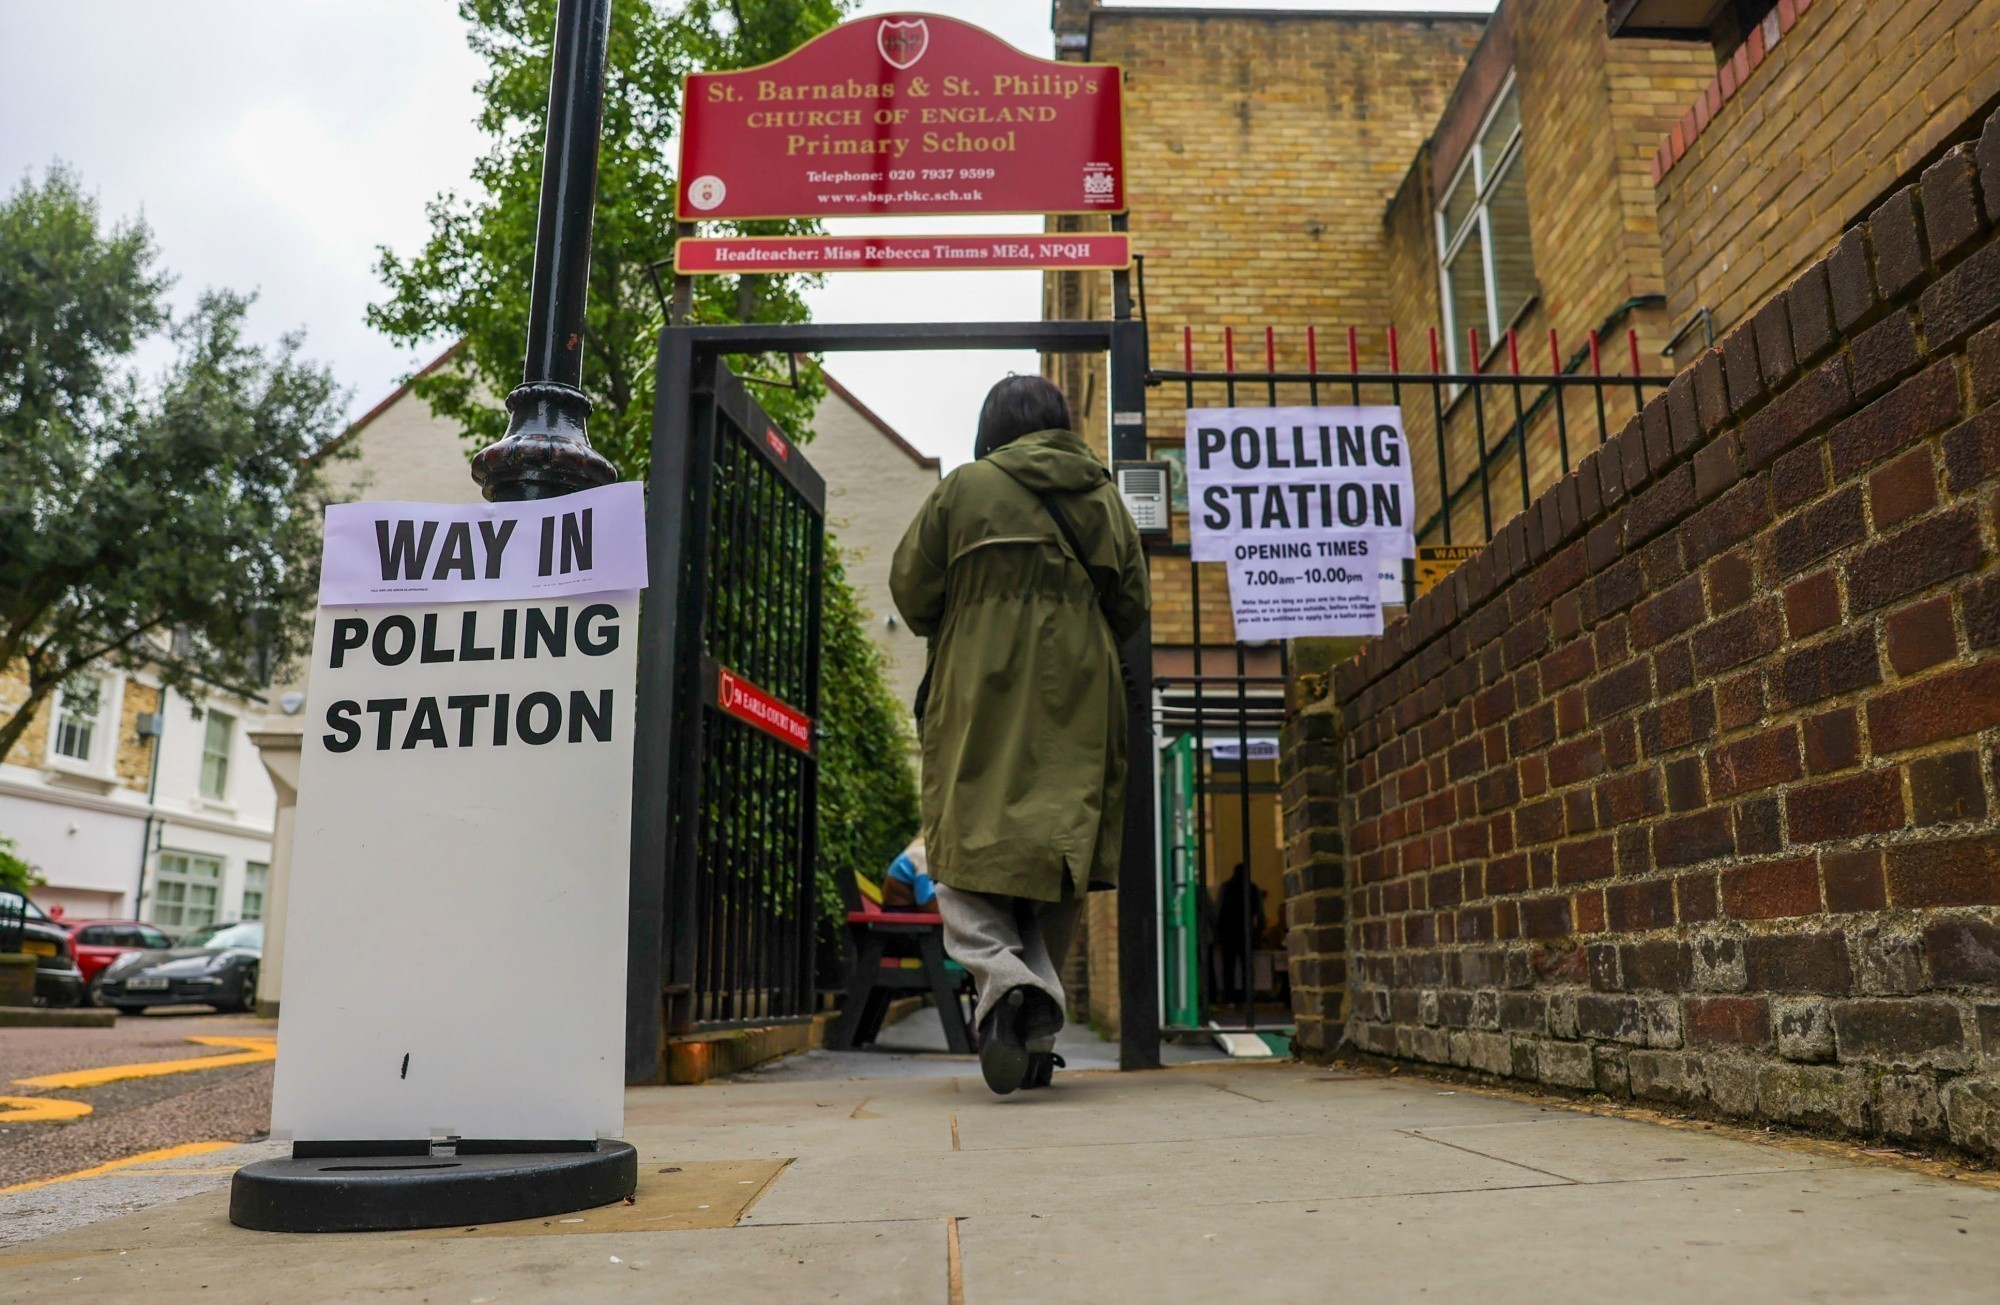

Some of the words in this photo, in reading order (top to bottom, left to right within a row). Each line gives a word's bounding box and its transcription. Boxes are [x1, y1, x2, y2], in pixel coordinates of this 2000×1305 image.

[707, 82, 744, 103] St.
[757, 78, 895, 102] Barnabas
[907, 76, 930, 97] &
[943, 75, 980, 97] St.
[993, 74, 1099, 99] Philip's
[747, 110, 862, 128] CHURCH
[874, 108, 909, 125] OF
[921, 106, 1057, 124] ENGLAND
[786, 134, 910, 158] Primary
[922, 131, 1016, 153] School
[806, 170, 883, 184] Telephone:
[888, 169, 915, 181] 020
[921, 169, 954, 180] 7937
[959, 168, 995, 179] 9599
[817, 189, 983, 204] www.sbsp.rbkc.sch.uk
[715, 247, 819, 262] Headteacher:
[823, 246, 861, 260] Miss
[864, 245, 930, 260] Rebecca
[933, 244, 988, 259] Timms
[992, 244, 1035, 260] MEd,
[1039, 243, 1091, 260] NPQH
[1197, 424, 1400, 470] POLLING
[1203, 482, 1402, 530] STATION
[375, 519, 518, 581] WAY
[538, 507, 593, 577] IN
[1234, 542, 1312, 560] OPENING
[1317, 540, 1368, 557] TIMES
[329, 603, 620, 669] POLLING
[322, 688, 614, 753] STATION
